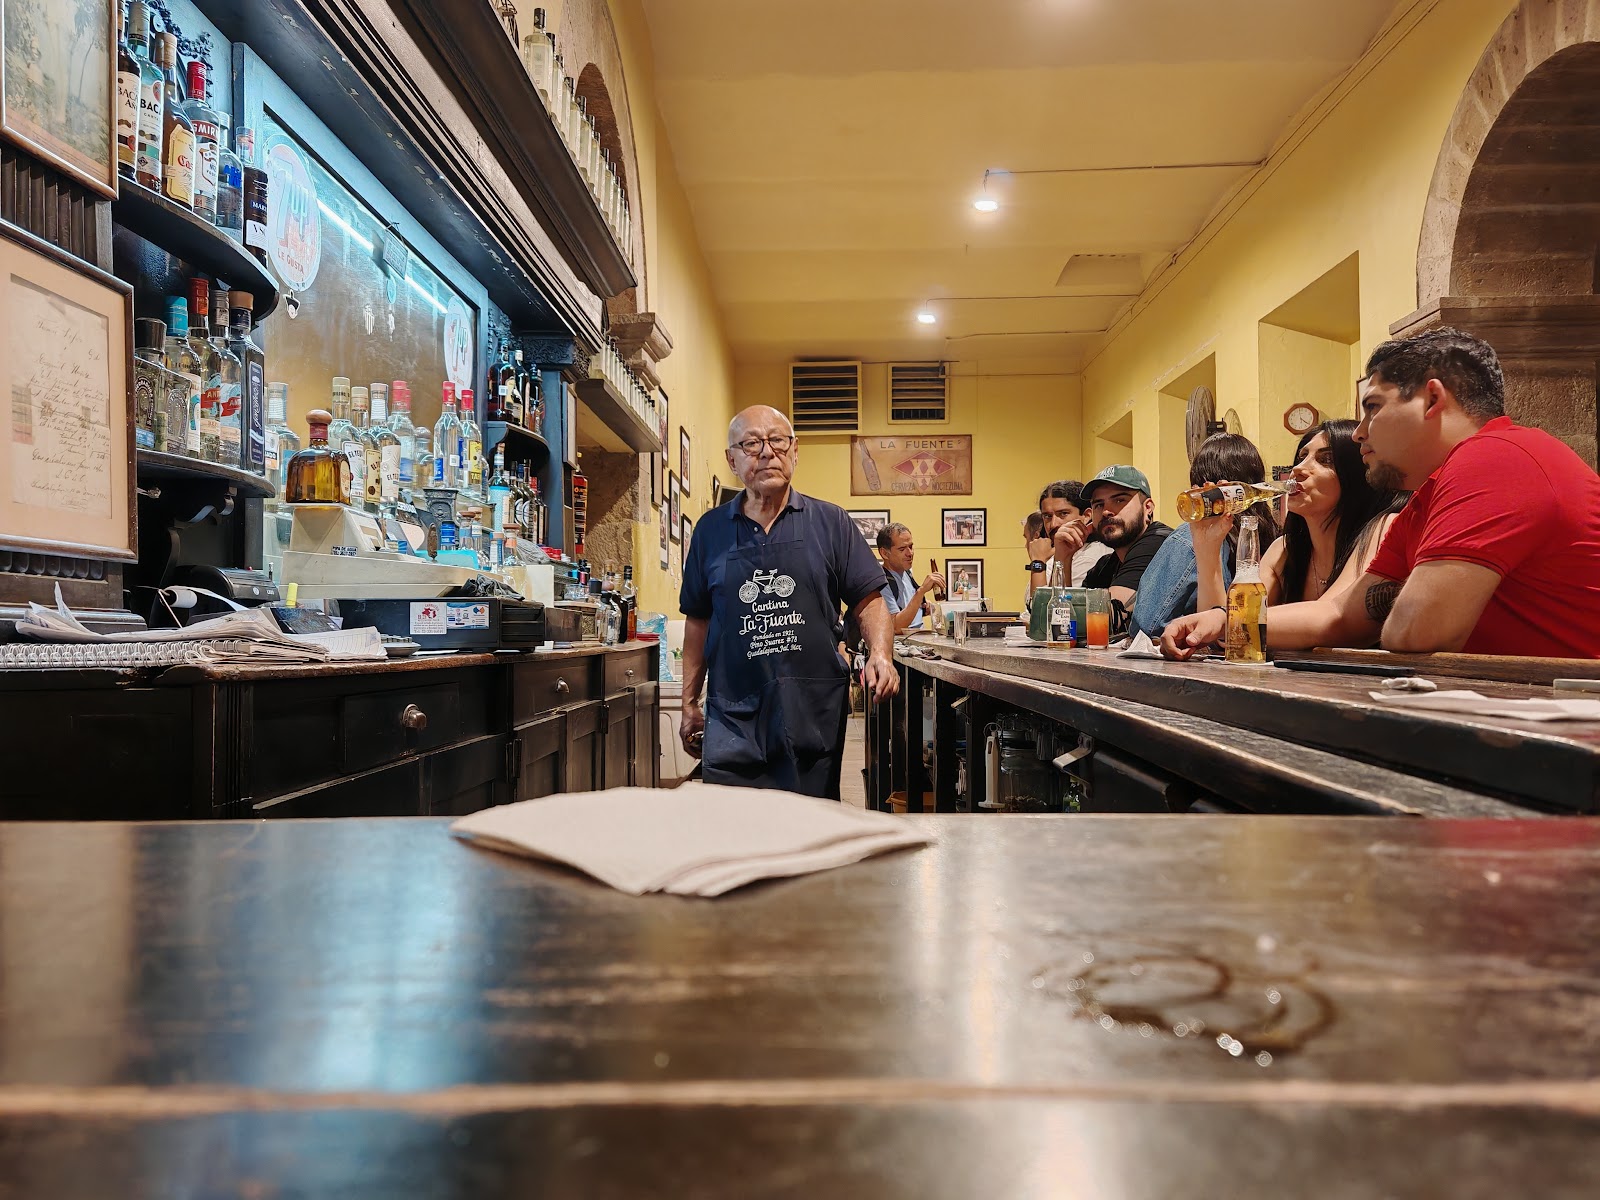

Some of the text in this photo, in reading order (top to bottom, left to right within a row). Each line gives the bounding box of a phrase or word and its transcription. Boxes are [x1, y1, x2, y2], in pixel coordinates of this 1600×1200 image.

[286, 255, 305, 274] GUSTA
[880, 440, 954, 449] LA FUENTE
[752, 600, 789, 613] Cantina
[739, 614, 757, 635] La
[750, 640, 763, 649] Pino
[786, 635, 798, 643] #78
[752, 631, 774, 641] Fundada
